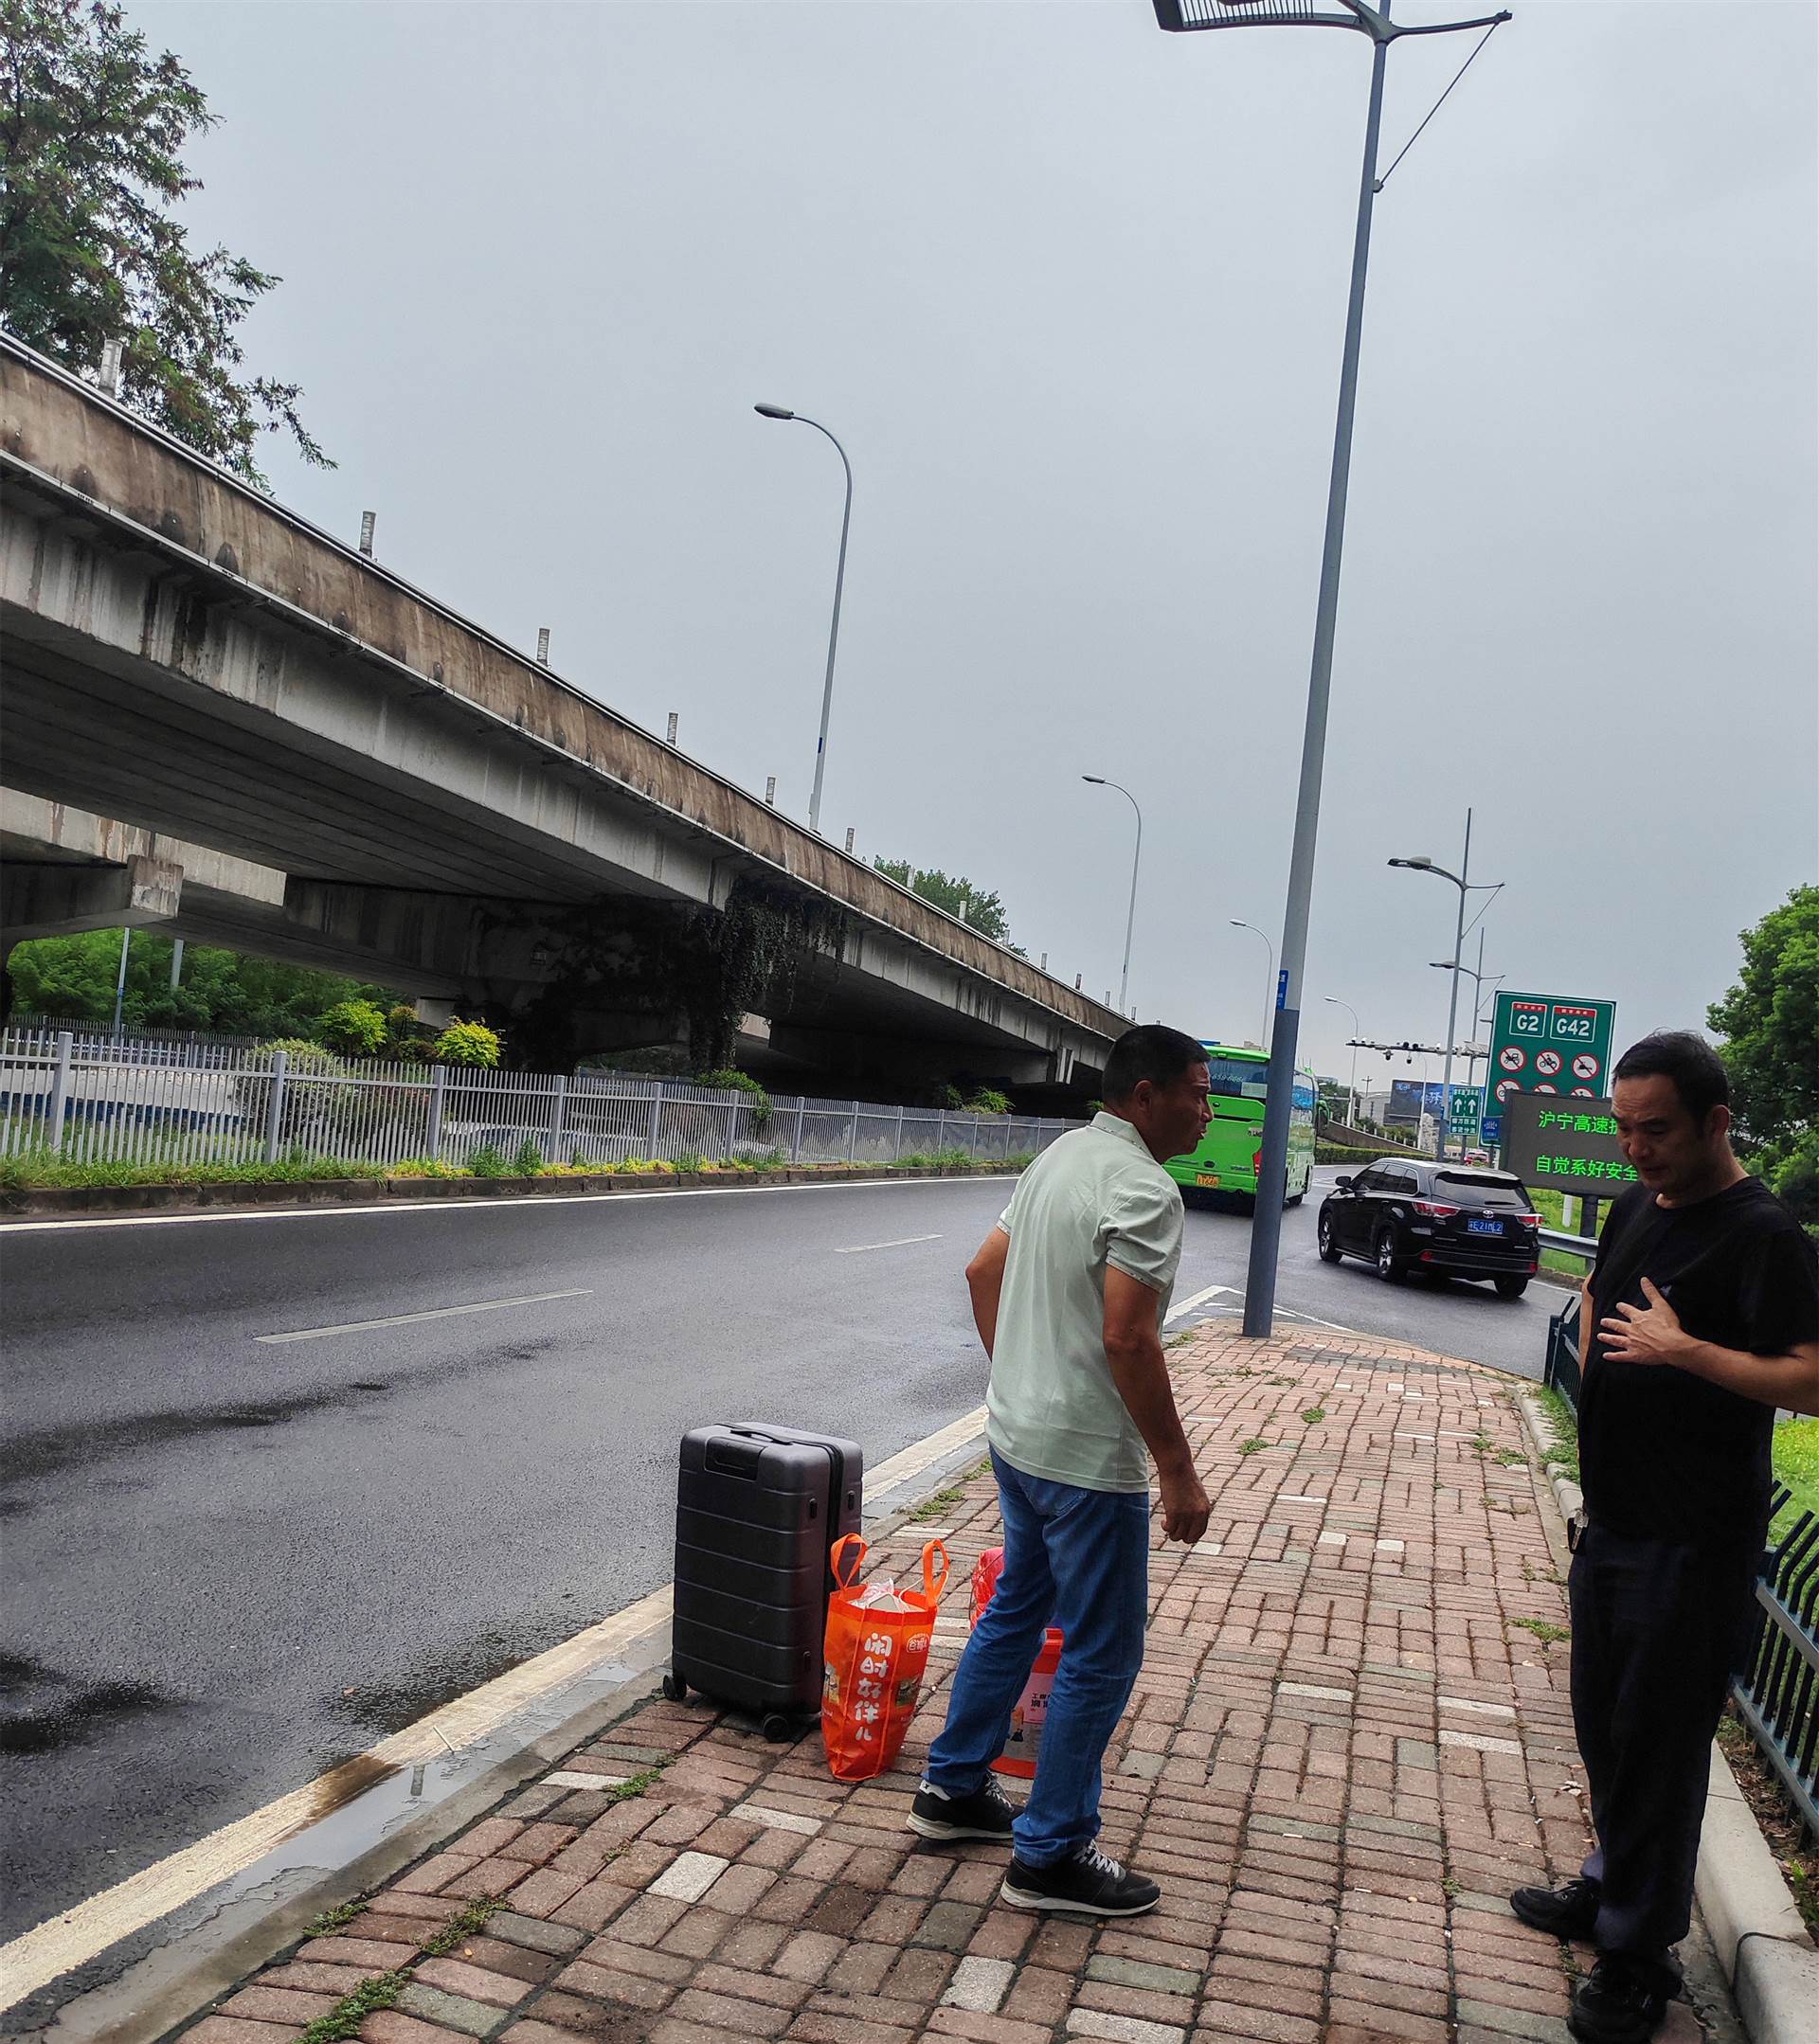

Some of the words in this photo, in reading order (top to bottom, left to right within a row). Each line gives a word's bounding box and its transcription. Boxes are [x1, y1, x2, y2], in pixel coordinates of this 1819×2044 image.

[1517, 1013, 1539, 1031] G2
[1556, 1018, 1590, 1036] G42
[1536, 1155, 1638, 1181] 自觉系好安全
[855, 1632, 892, 1742] 闲时好伴儿
